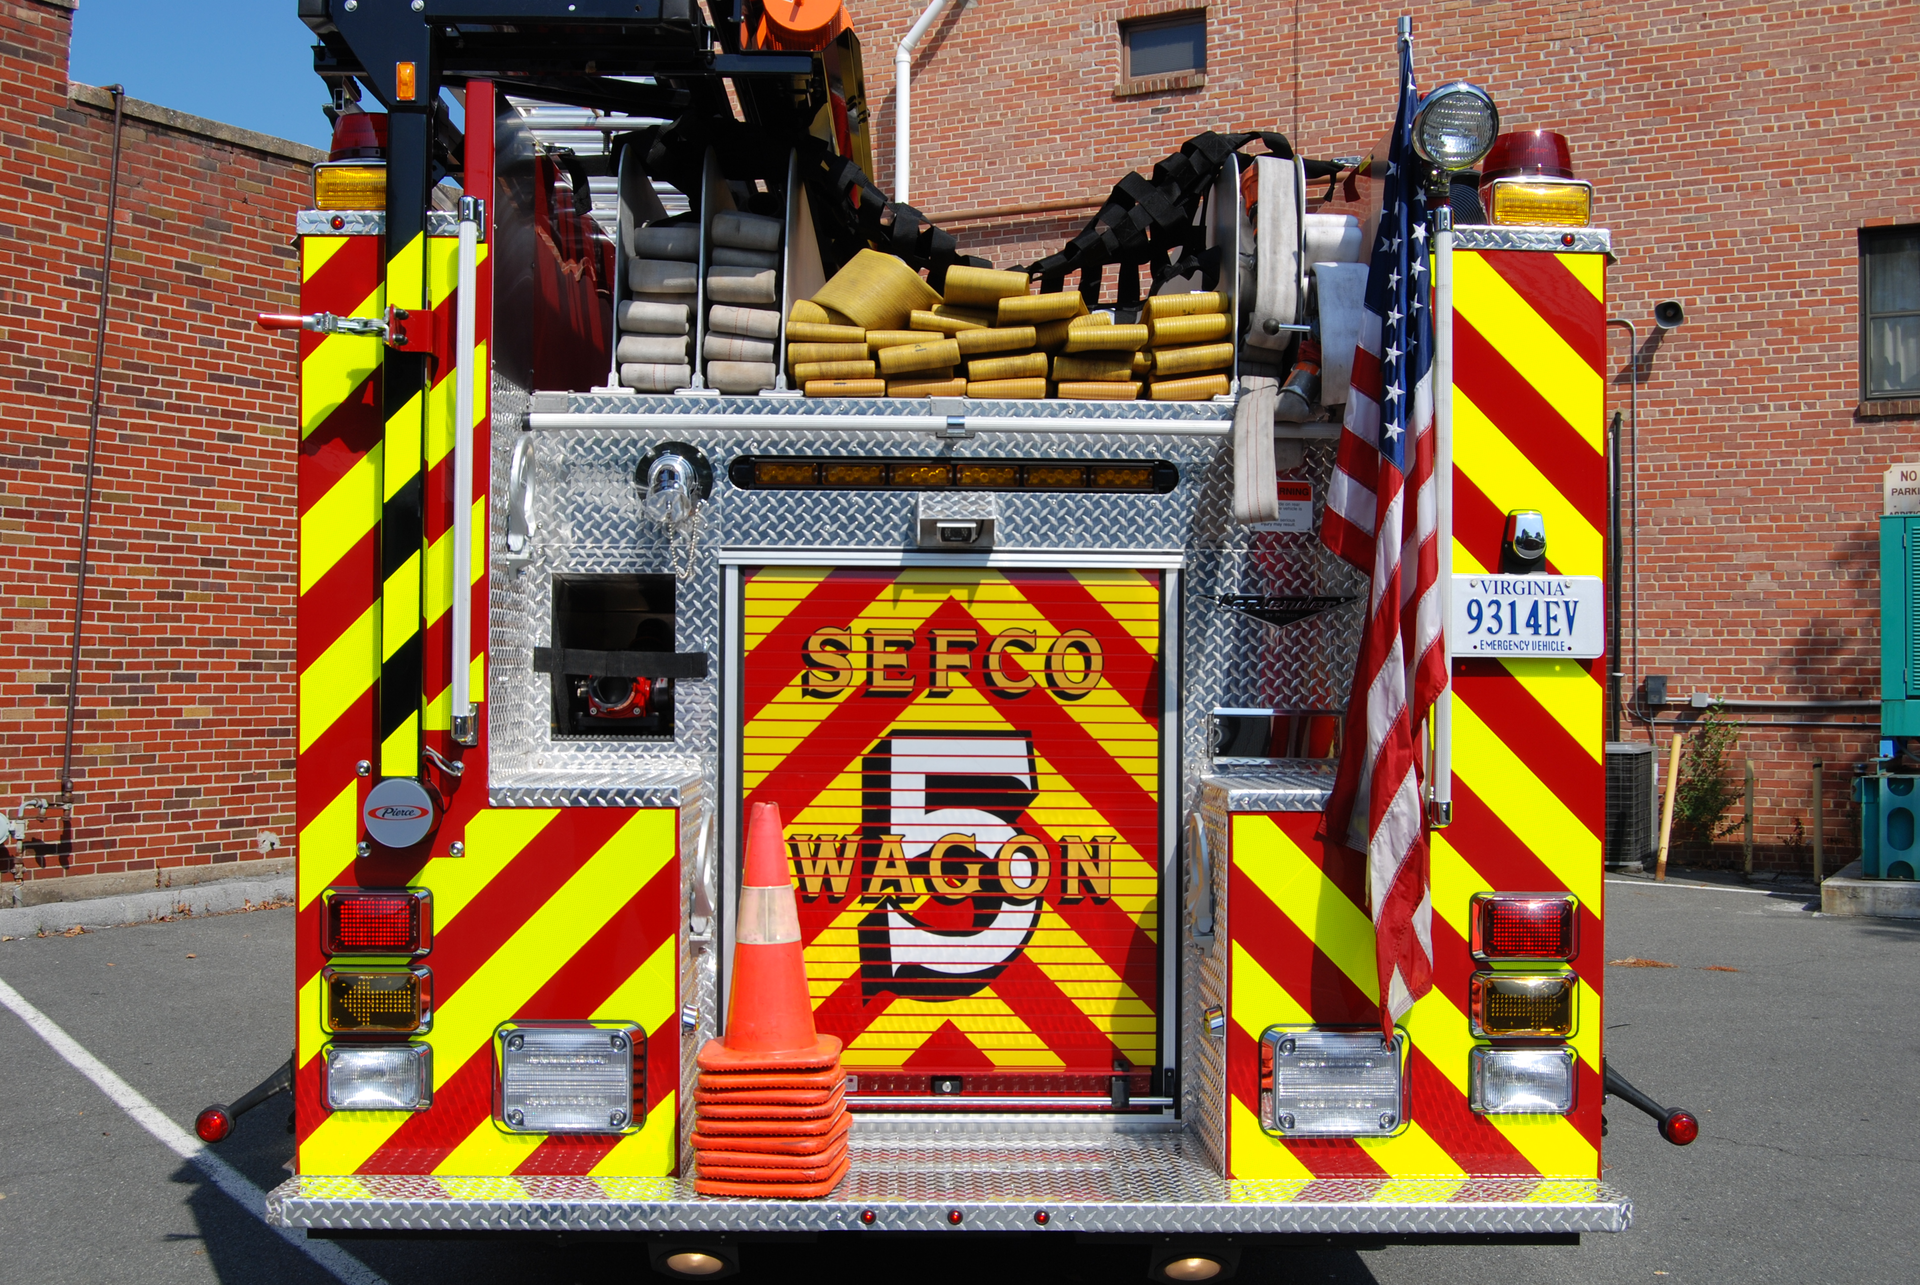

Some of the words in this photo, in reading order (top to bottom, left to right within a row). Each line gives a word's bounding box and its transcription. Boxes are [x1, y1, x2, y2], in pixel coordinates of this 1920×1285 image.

[1900, 470, 1917, 481] NO
[1279, 487, 1309, 496] RNING
[1480, 579, 1566, 596] VIRGINIA
[1466, 598, 1580, 637] 9314EV
[1479, 639, 1530, 651] EMERGENCY
[1531, 640, 1566, 652] VEHICLE
[800, 625, 1105, 701] SEFCO
[381, 807, 415, 818] Pierce
[784, 832, 1117, 907] WAGON
[857, 728, 1040, 1008] 5
